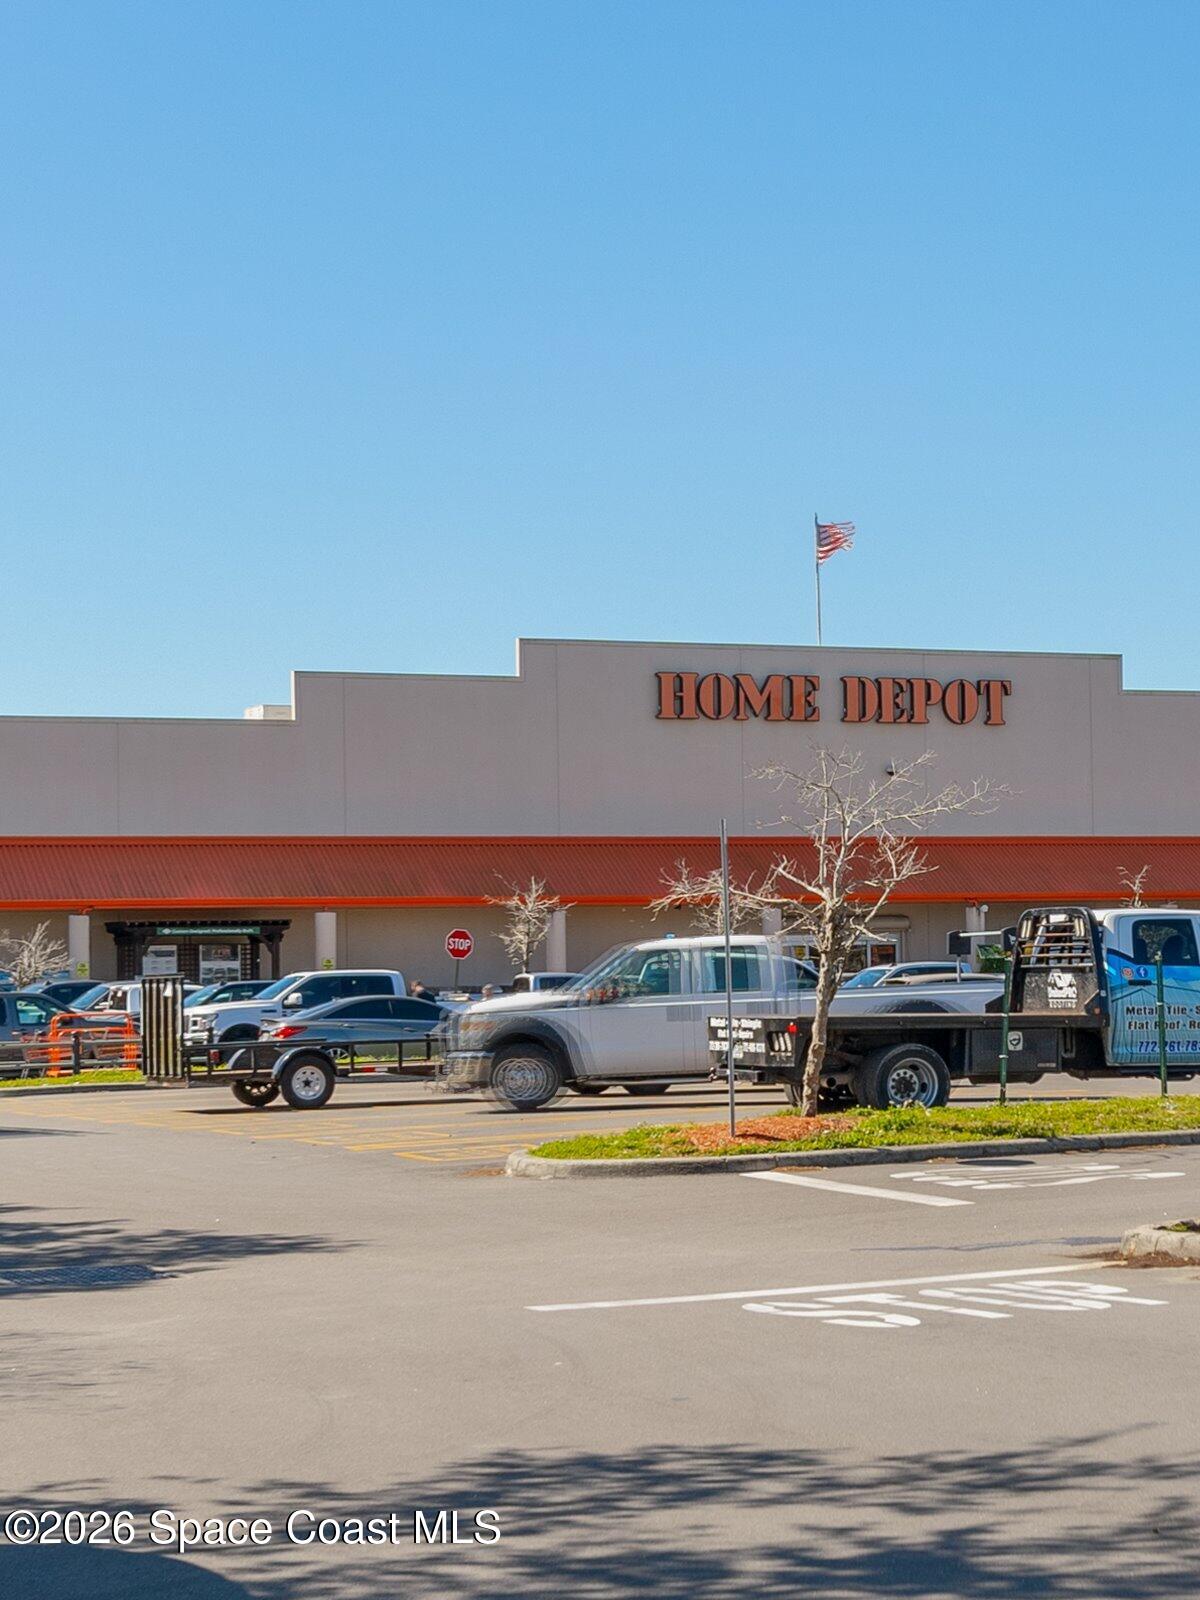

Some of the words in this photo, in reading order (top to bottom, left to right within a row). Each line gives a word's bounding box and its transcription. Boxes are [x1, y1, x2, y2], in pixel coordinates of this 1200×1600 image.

[655, 671, 820, 722] HOME
[840, 676, 1012, 725] DEPOT
[448, 938, 471, 950] STOP
[1126, 1006, 1158, 1015] Metal
[1167, 1005, 1188, 1015] Tile
[1128, 1021, 1149, 1030] Flat
[742, 1280, 1169, 1327] STOP
